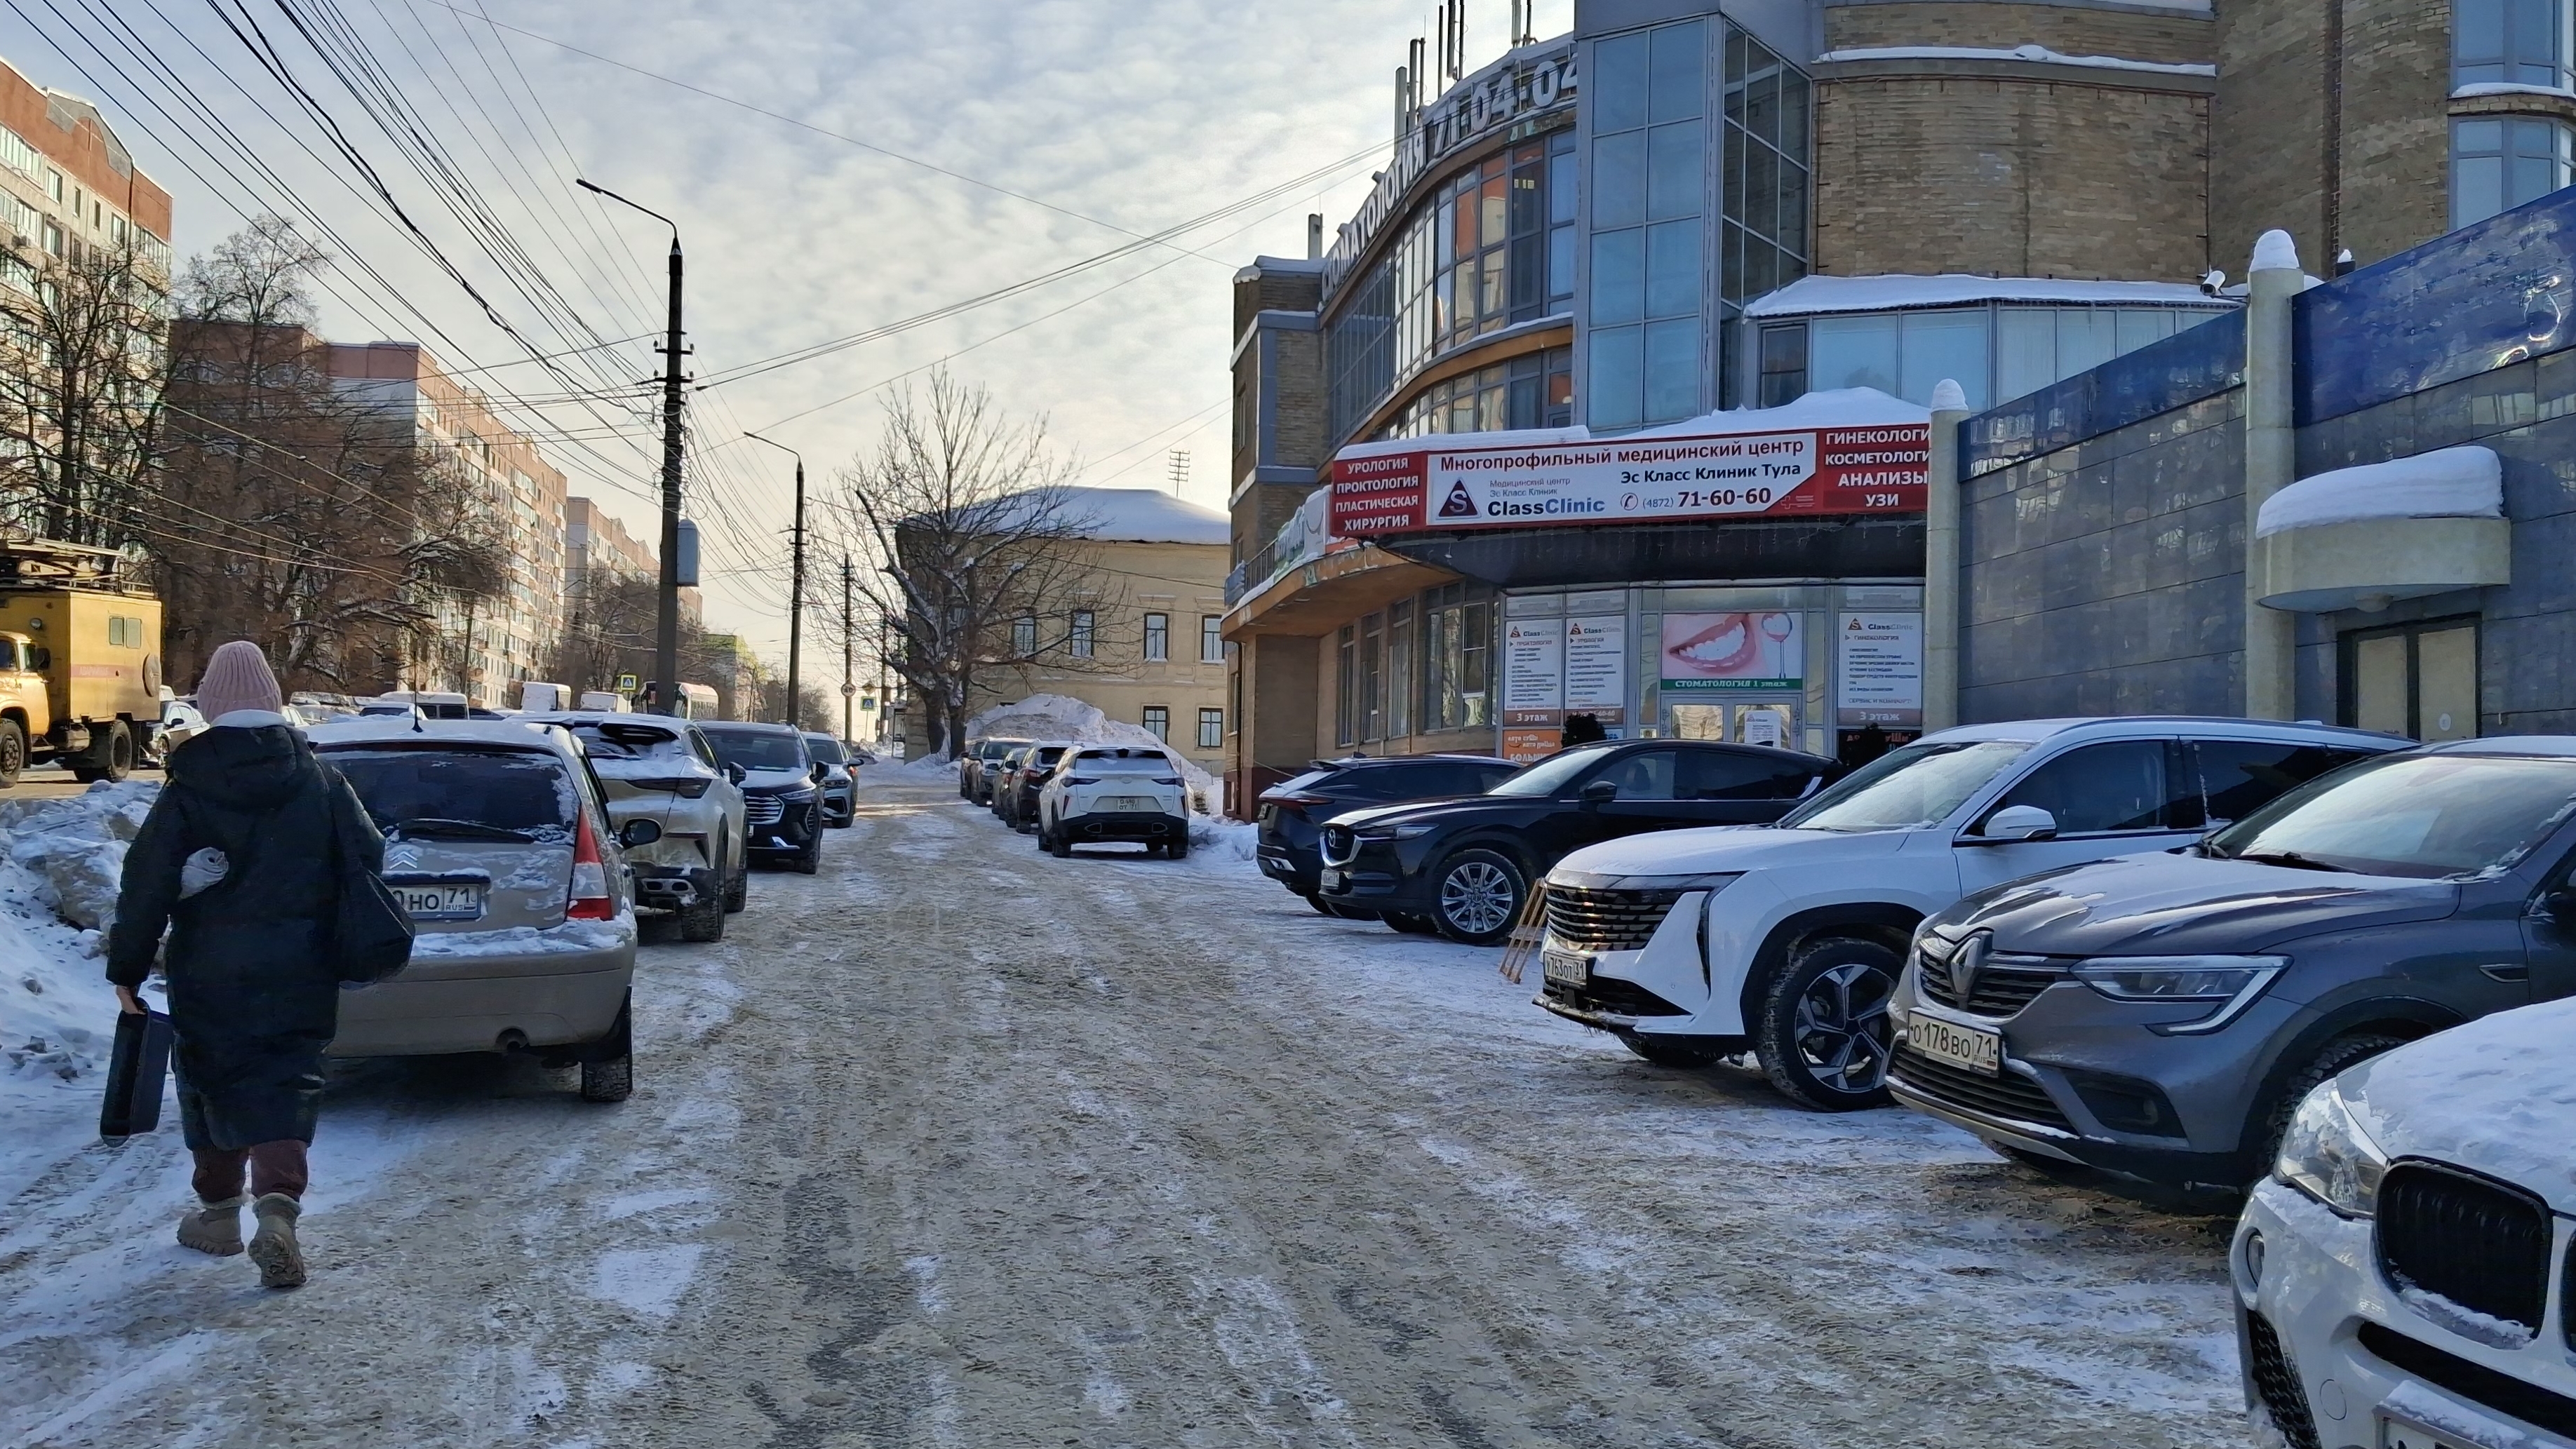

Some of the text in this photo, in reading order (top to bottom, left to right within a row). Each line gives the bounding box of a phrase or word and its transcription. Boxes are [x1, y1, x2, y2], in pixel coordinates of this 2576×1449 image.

[1826, 429, 1931, 445] ГИНЕКОЛОГИ
[1441, 440, 1804, 471] Многопрофильный медицинский центр
[1825, 450, 1930, 466] КОСМЕТОЛОГИ
[1348, 457, 1409, 475] УРОЛОГИЯ
[1621, 463, 1801, 484] Эс Класс Клиник Тула
[1336, 476, 1418, 494] ПРОКТОЛОГИЯ
[1838, 471, 1928, 487] АНАЛИЗЫ
[1336, 495, 1418, 513] ПЛАСТИЧЕСКАЯ
[1449, 490, 1468, 513] S
[1487, 497, 1606, 516] ClassClinic
[1642, 487, 1771, 508] (4872) 71-60-60
[1865, 494, 1899, 507] УЗИ
[1344, 515, 1409, 532] ХИРУРГИЯ
[1860, 712, 1866, 720] 3
[447, 887, 470, 903] 71
[1976, 1034, 1992, 1057] 71
